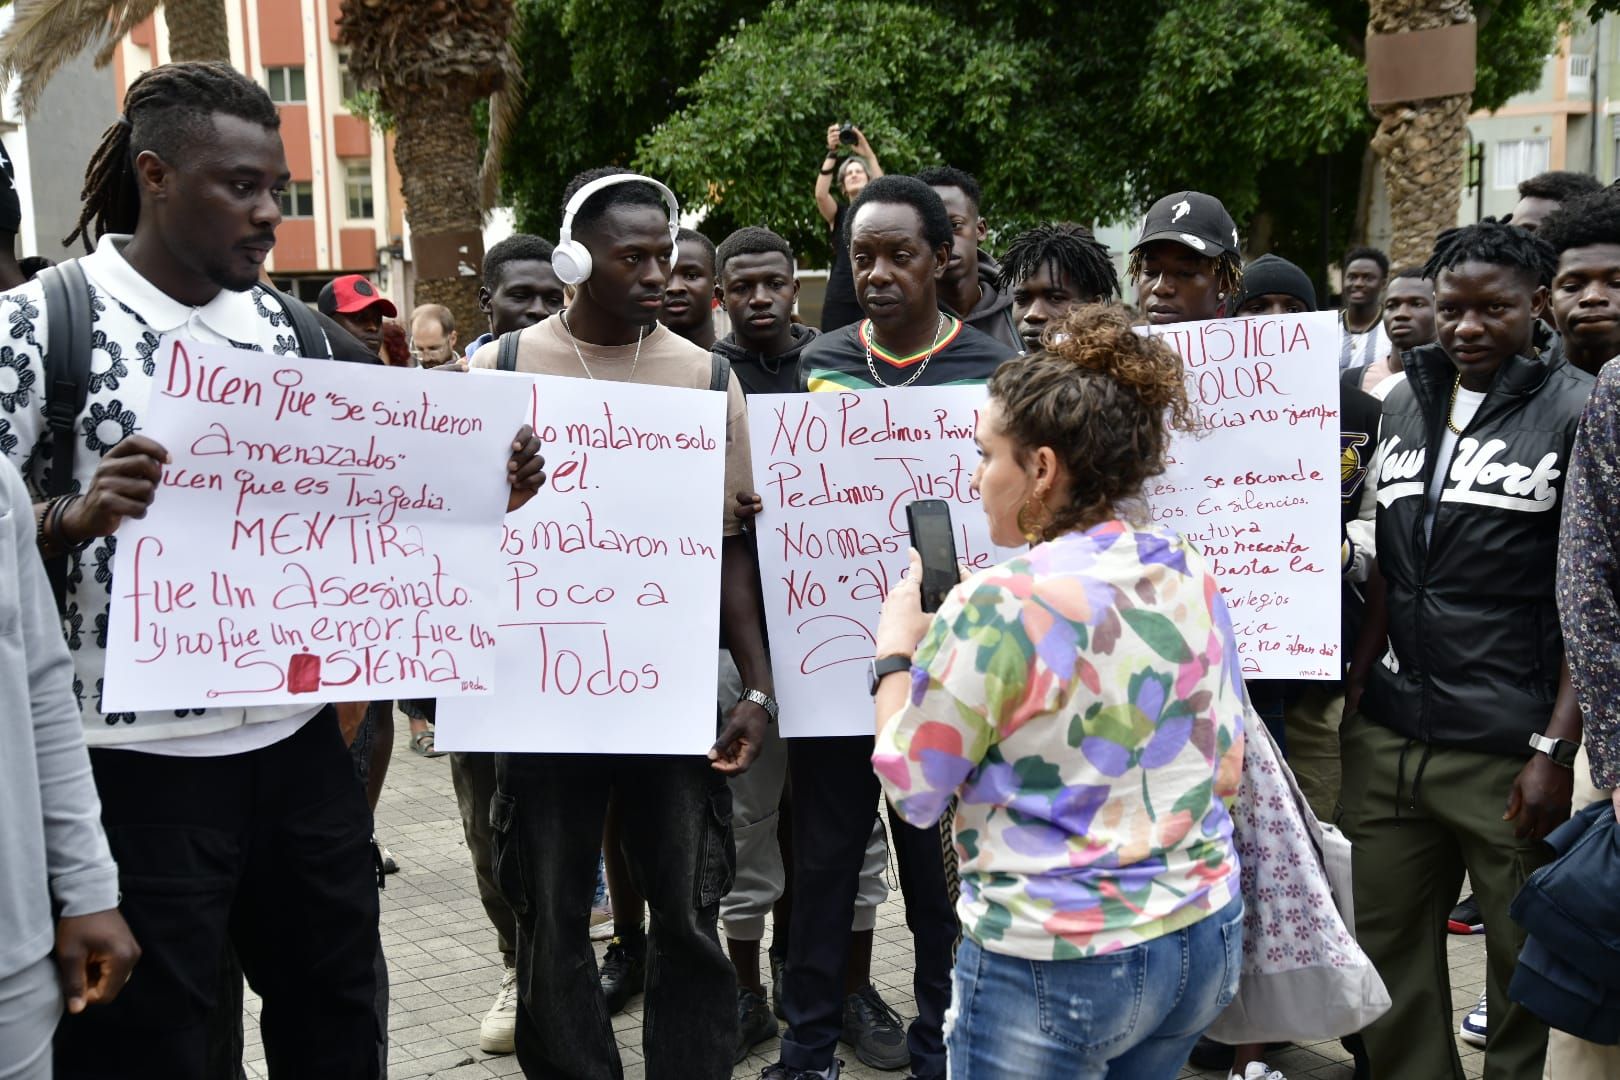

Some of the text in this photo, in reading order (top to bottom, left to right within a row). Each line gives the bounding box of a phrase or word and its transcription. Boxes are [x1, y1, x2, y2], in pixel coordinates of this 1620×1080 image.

[161, 341, 262, 407] Dicen
[566, 401, 672, 451] mataron
[677, 425, 716, 451] solo
[838, 392, 932, 448] Pedimos
[934, 408, 979, 440] Privil
[1250, 409, 1278, 423] no
[161, 468, 222, 491] icen
[295, 477, 329, 496] es
[551, 450, 600, 493] él.
[1234, 458, 1323, 485] esconde
[1377, 435, 1561, 500] New York
[766, 454, 981, 534] Pedimos Justi
[1151, 504, 1188, 521] tos.
[531, 501, 668, 558] mataron
[1187, 523, 1261, 541] uctura
[1204, 533, 1310, 557] no necesita
[506, 561, 669, 611] Poco a
[1214, 555, 1325, 575] basta la
[124, 535, 196, 643] fue
[1227, 591, 1289, 612] ivilegios
[176, 630, 214, 656] no
[218, 616, 260, 662] fue
[412, 609, 462, 657] fue
[498, 621, 660, 696] Todos
[1259, 640, 1280, 652] no
